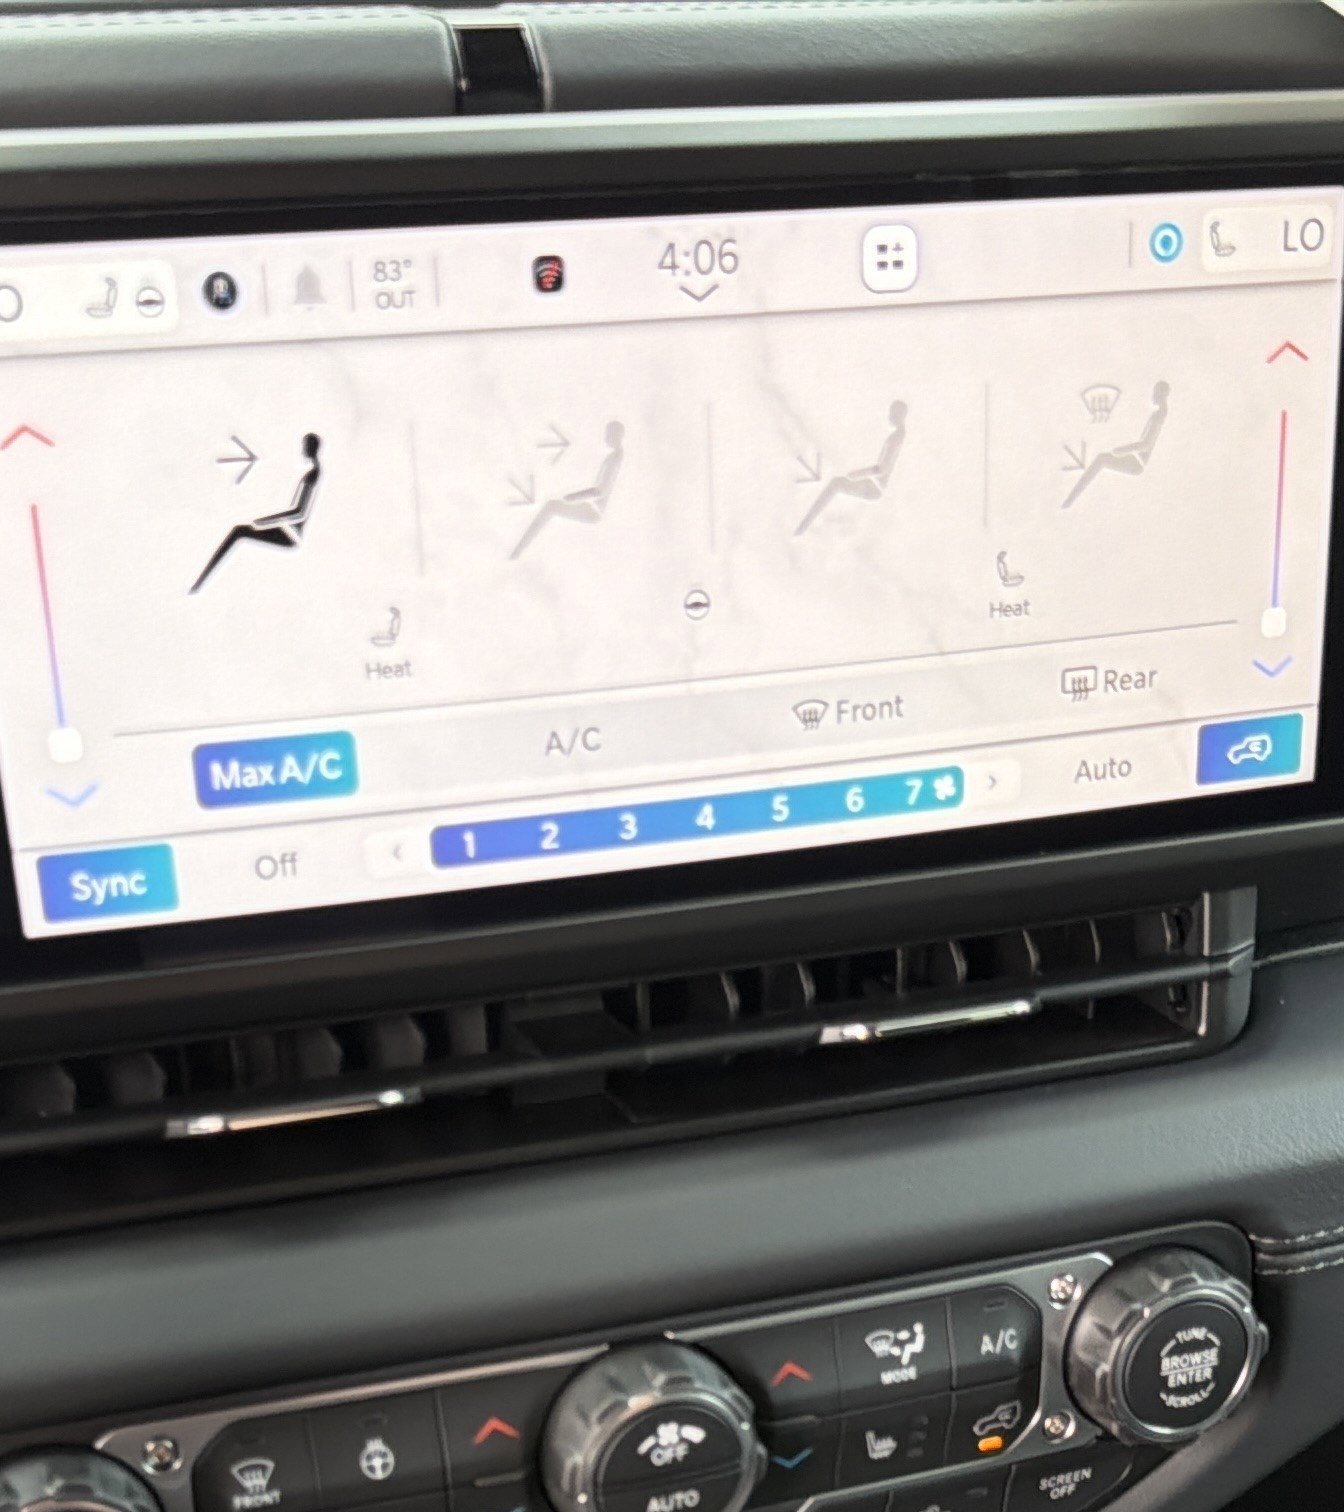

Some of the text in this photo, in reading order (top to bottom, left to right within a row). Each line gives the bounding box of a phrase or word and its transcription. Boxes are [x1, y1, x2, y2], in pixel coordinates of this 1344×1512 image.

[1281, 216, 1326, 255] LO
[657, 238, 740, 278] 4:06
[373, 287, 417, 311] OUT
[988, 599, 1031, 618] Heat
[364, 659, 413, 680] Heat
[1103, 664, 1158, 692] Rear
[836, 694, 905, 725] Front
[544, 726, 603, 758] A/C
[209, 749, 344, 791] Max A/C
[1074, 755, 1133, 783] Auto
[463, 778, 924, 859] 1 2 3 4 5 6 7
[254, 850, 300, 881] Off
[70, 869, 149, 906] Sync
[980, 1328, 1018, 1355] A/C
[1175, 1326, 1207, 1344] TUNE
[1160, 1346, 1219, 1371] BROWSE
[880, 1365, 918, 1385] MODE
[1167, 1366, 1213, 1388] ENTER
[1164, 1389, 1209, 1408] SCROLL
[650, 1440, 690, 1467] OFF
[1038, 1467, 1092, 1491] SCREEN
[1049, 1483, 1077, 1500] OFF
[231, 1487, 282, 1511] FRONT
